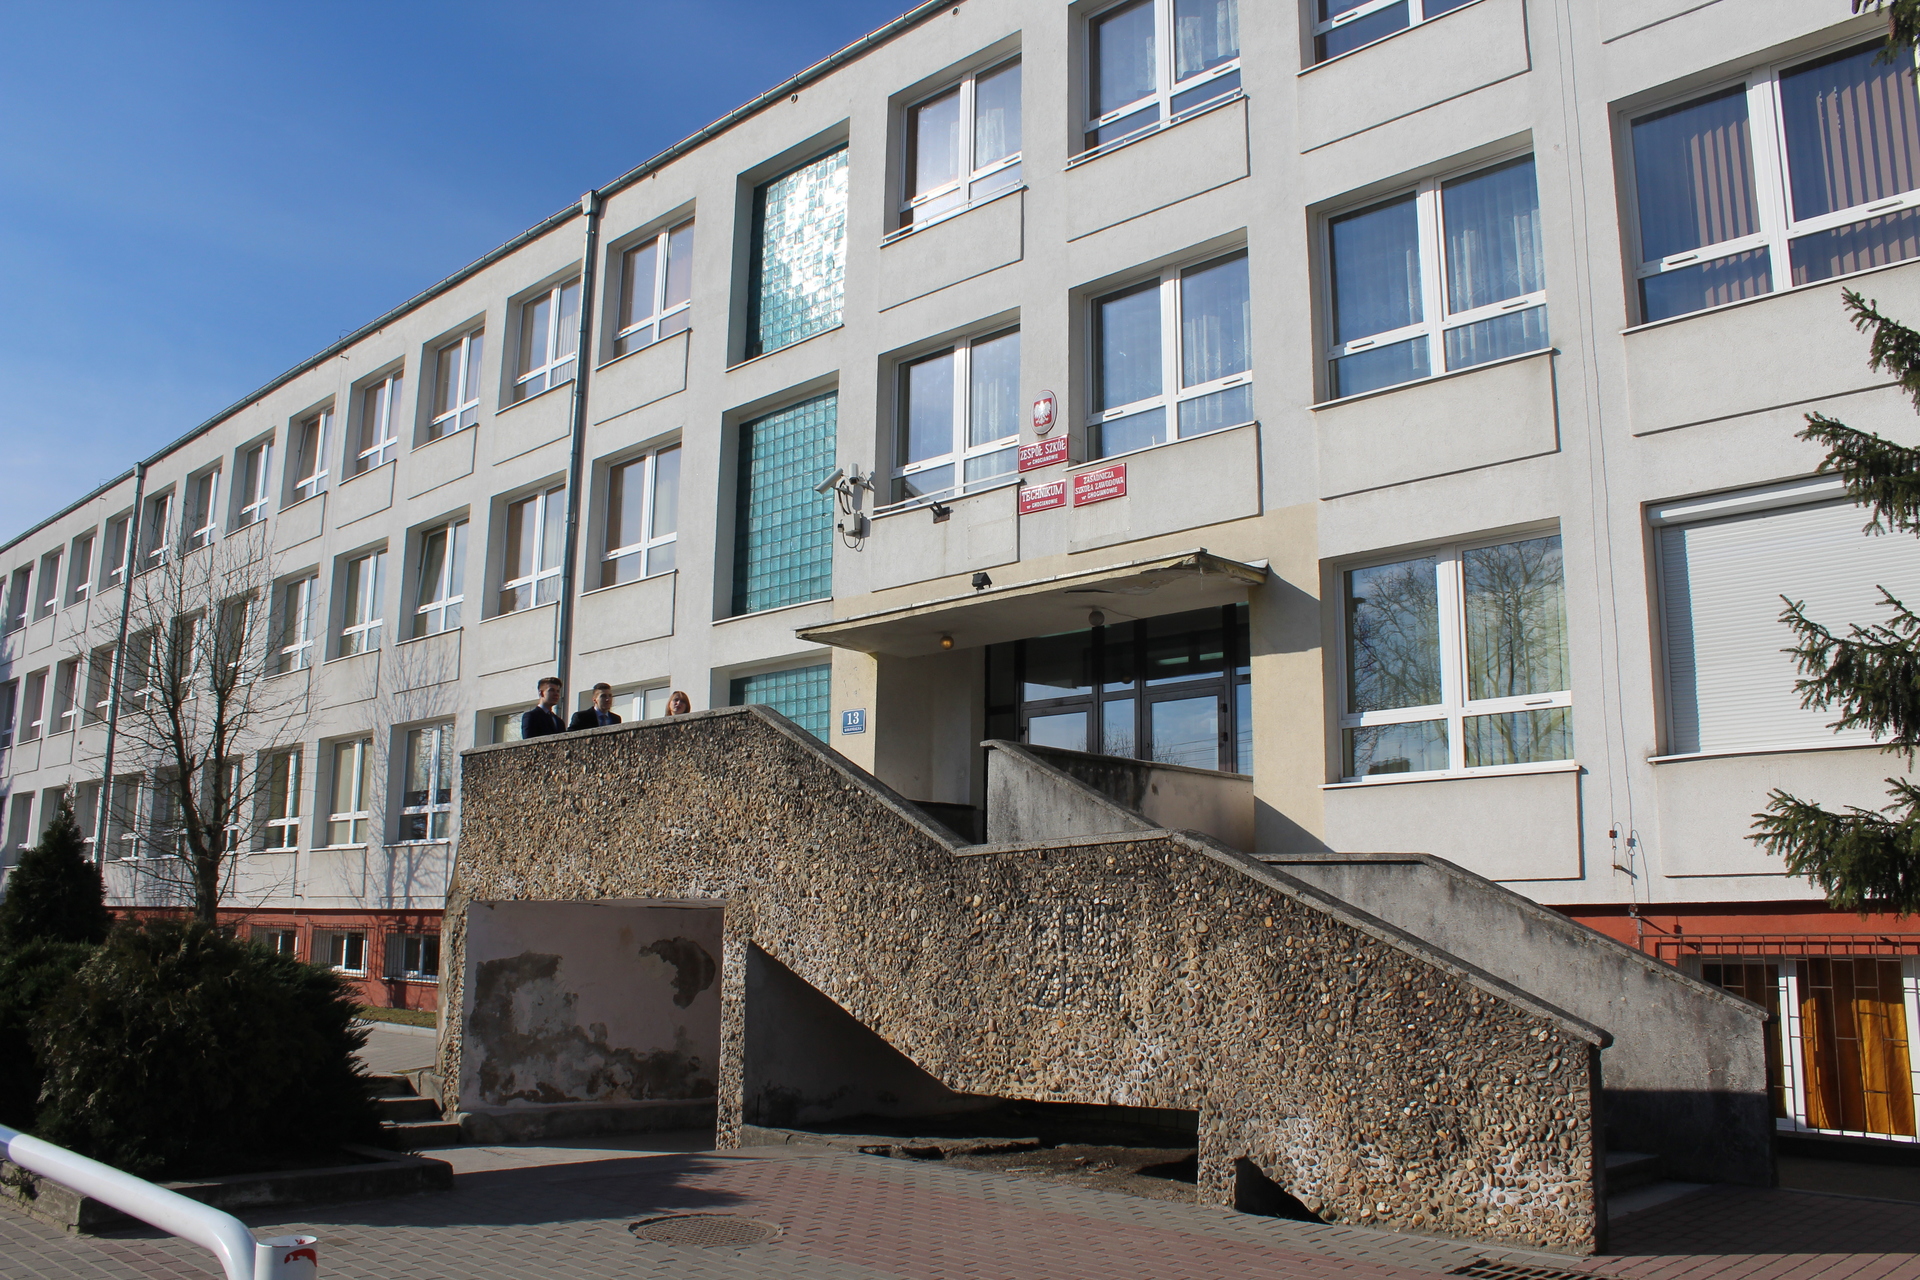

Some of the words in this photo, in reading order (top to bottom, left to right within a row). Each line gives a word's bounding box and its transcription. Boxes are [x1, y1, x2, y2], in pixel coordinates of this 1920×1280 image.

[1083, 471, 1115, 484] ZASADNICZA
[1022, 484, 1063, 502] TECHNIKUM
[847, 712, 860, 725] 13
